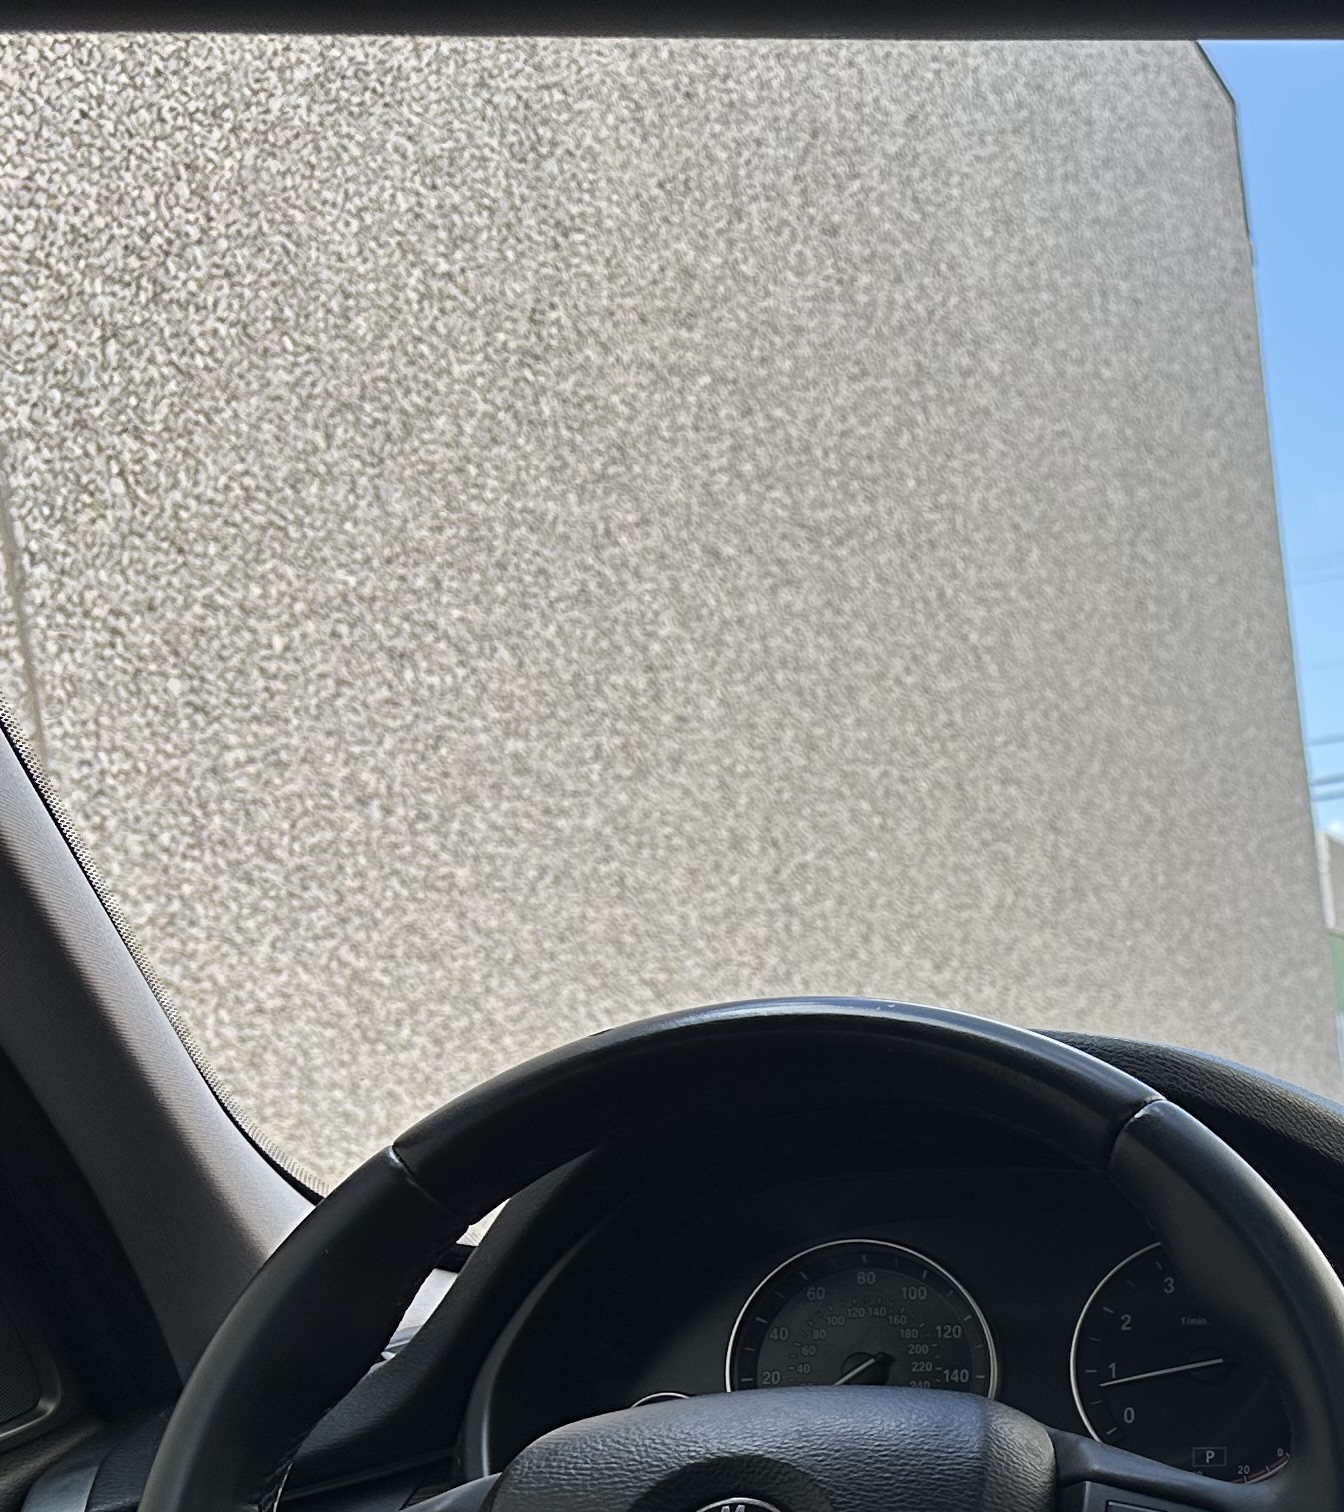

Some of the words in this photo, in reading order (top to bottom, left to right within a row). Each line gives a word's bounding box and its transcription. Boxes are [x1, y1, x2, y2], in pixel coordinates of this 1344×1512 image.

[856, 1271, 876, 1285] 80
[1163, 1276, 1175, 1294] 3
[806, 1286, 825, 1301] 60
[901, 1286, 928, 1301] 100
[847, 1307, 866, 1318] 120
[867, 1306, 887, 1317] 140
[827, 1315, 845, 1327] 100
[888, 1314, 907, 1326] 160
[1120, 1314, 1133, 1331] 2
[769, 1326, 789, 1341] 40
[811, 1328, 827, 1340] 80
[900, 1327, 919, 1340] 180
[935, 1324, 963, 1340] 120
[802, 1344, 817, 1356] 60
[907, 1343, 929, 1355] 200
[796, 1362, 811, 1374] 40
[911, 1361, 933, 1373] 220
[1108, 1362, 1117, 1379] 1
[762, 1371, 781, 1385] 20
[943, 1368, 969, 1384] 140
[1123, 1407, 1135, 1424] 0
[1205, 1450, 1215, 1464] P
[1237, 1465, 1250, 1475] 20
